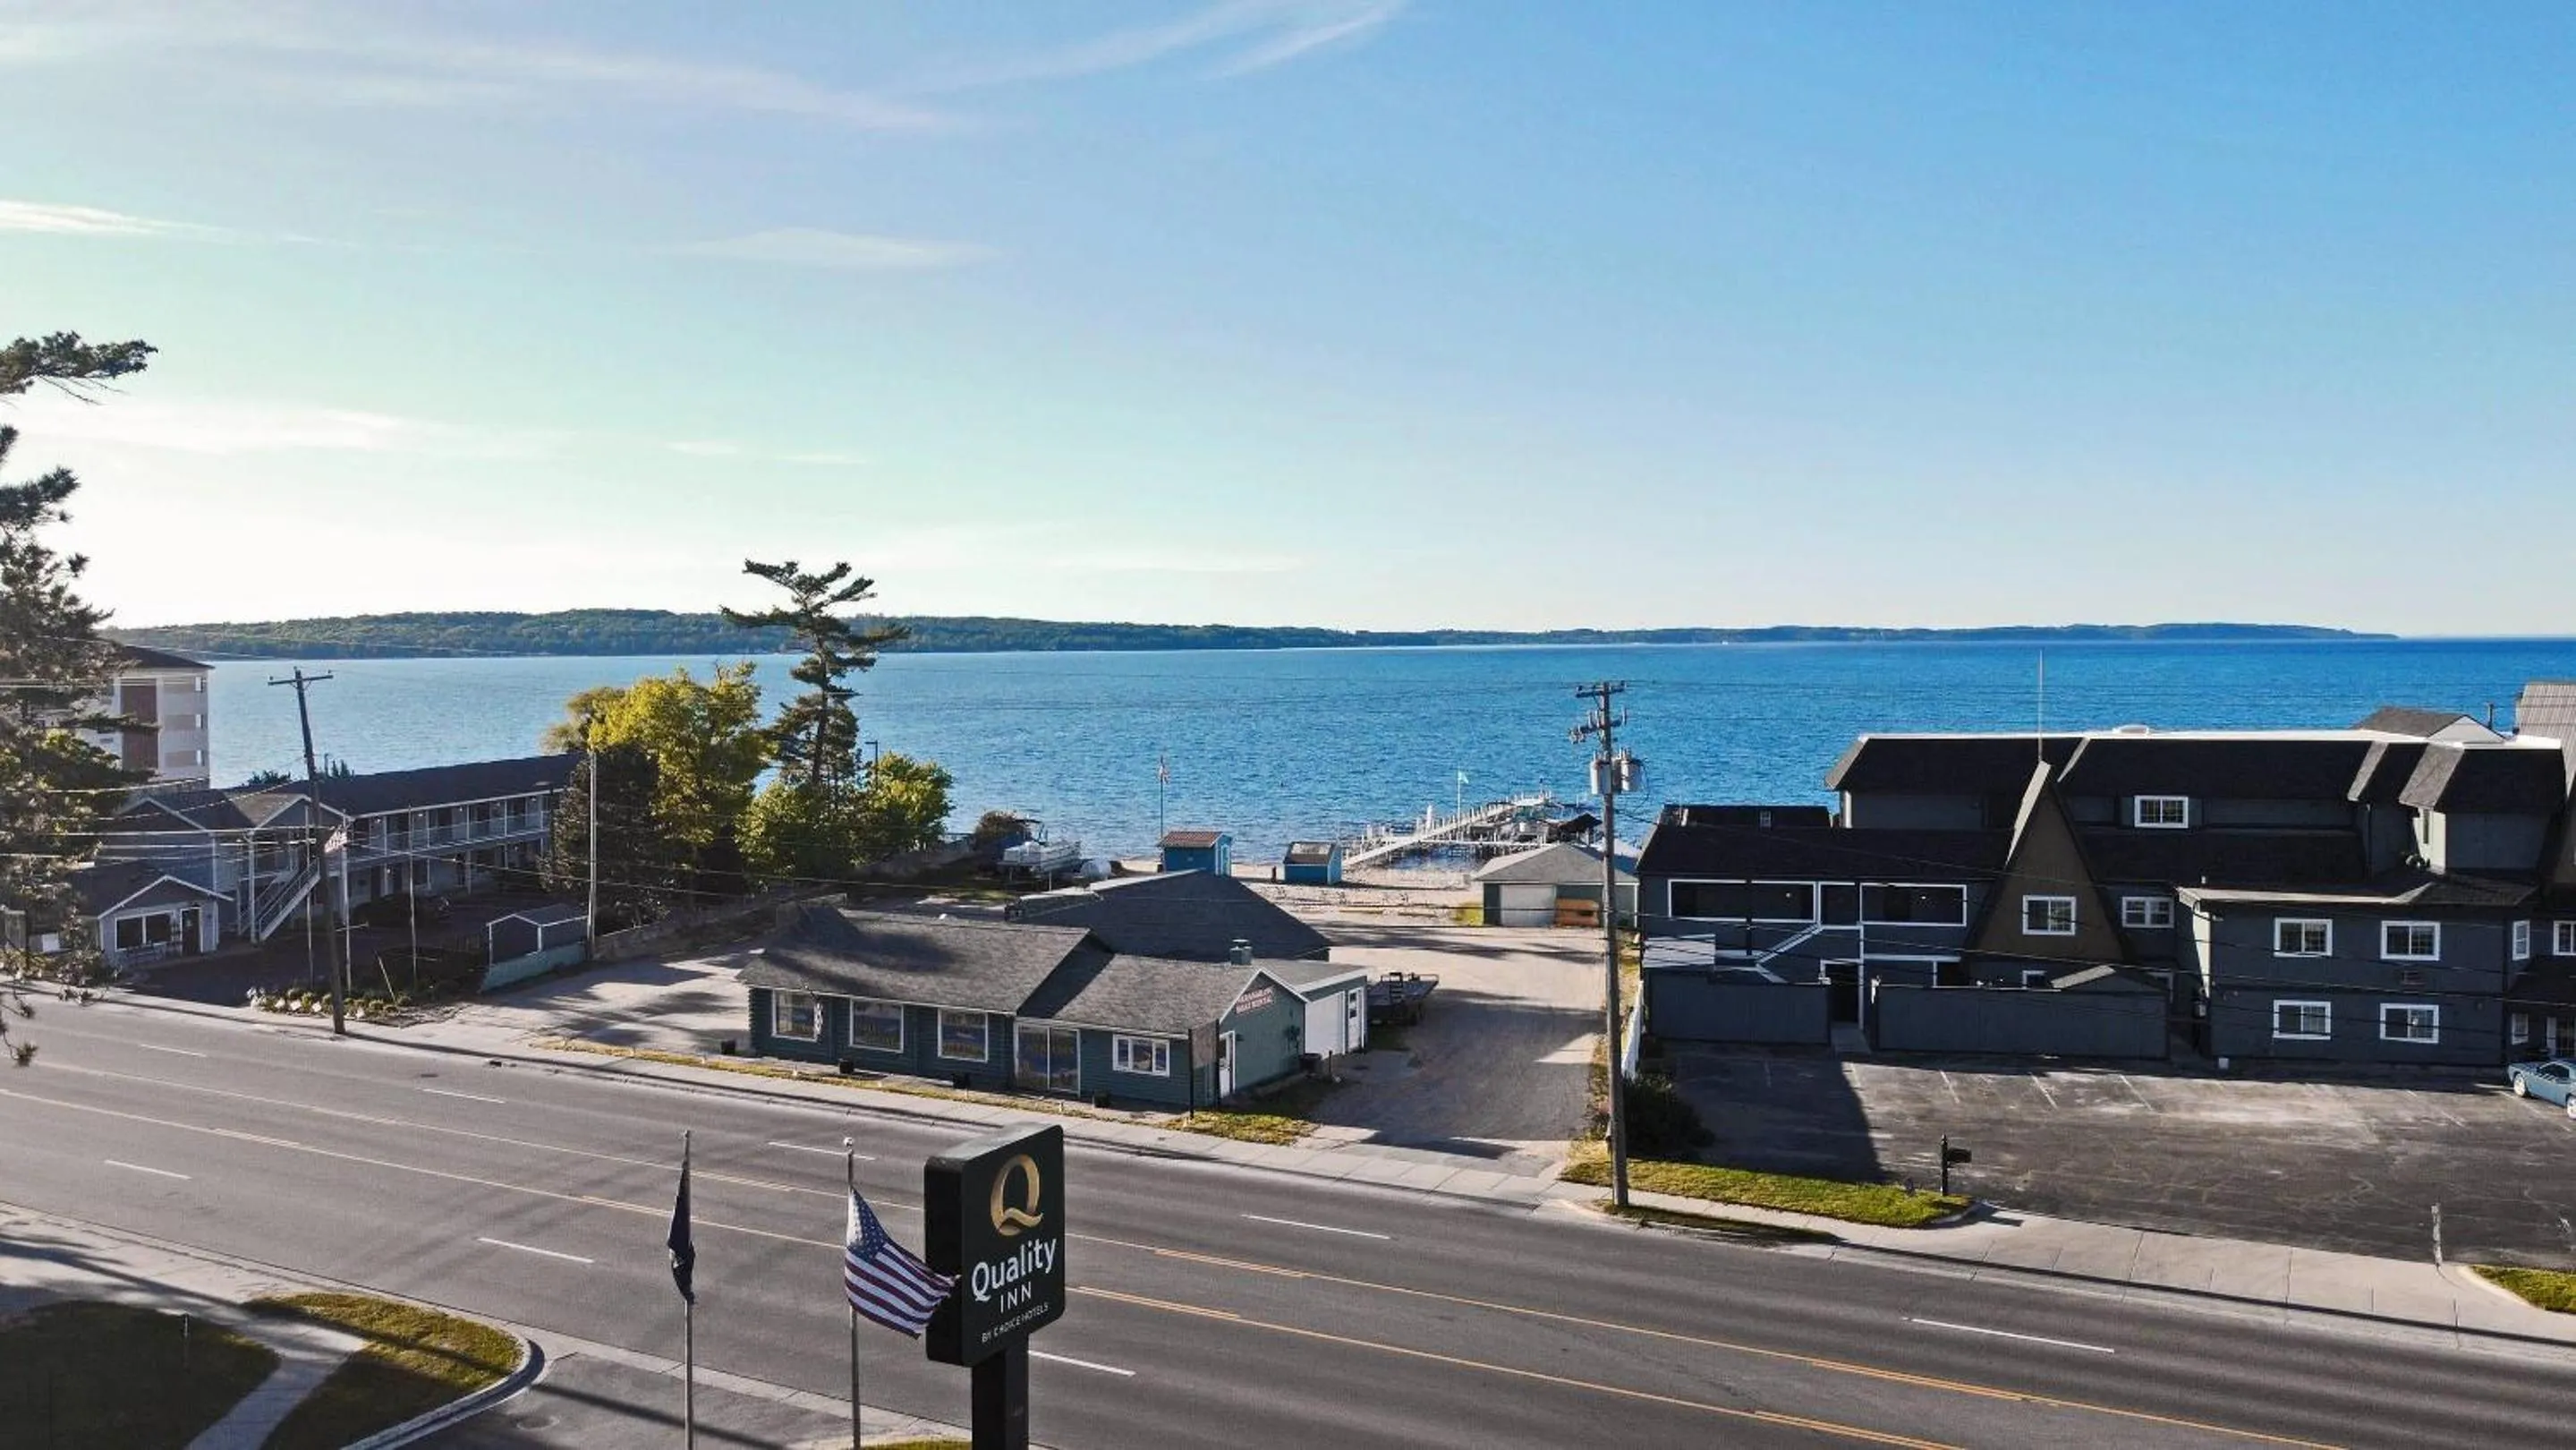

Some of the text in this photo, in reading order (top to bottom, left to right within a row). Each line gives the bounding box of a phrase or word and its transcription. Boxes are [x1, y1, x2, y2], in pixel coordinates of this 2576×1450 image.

[990, 1154, 1043, 1236] Q
[972, 1239, 1057, 1301] Quality
[982, 1301, 1049, 1343] BY CHOICE HOTELS
[1000, 1281, 1032, 1314] INN
